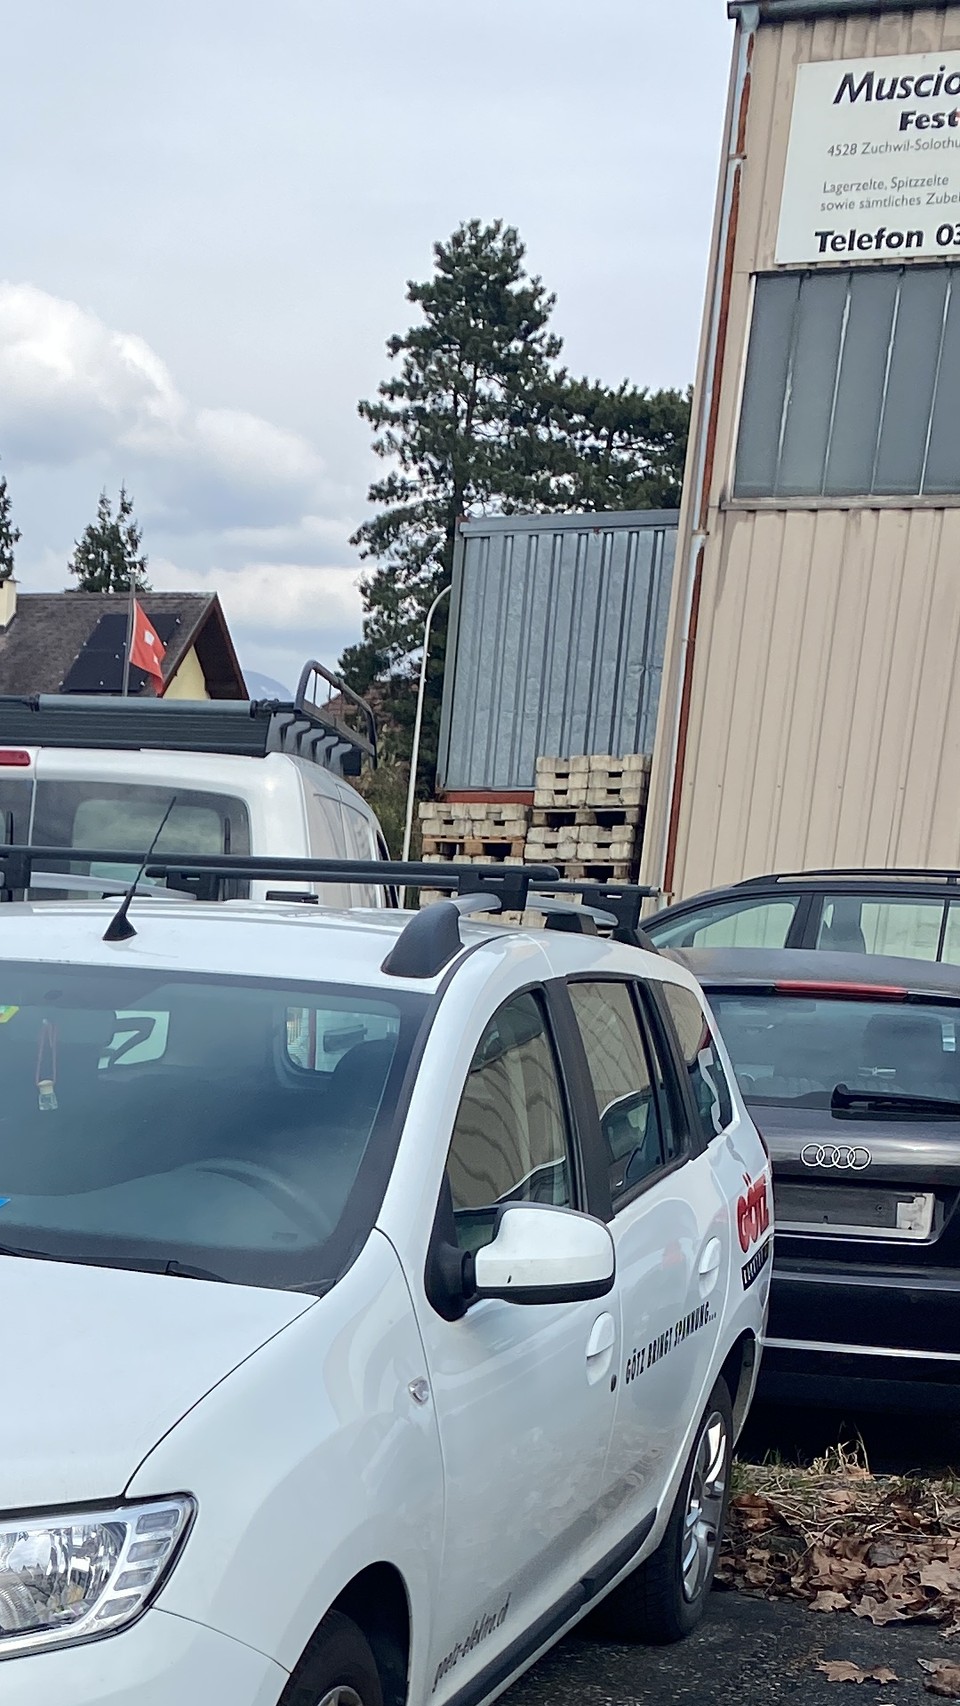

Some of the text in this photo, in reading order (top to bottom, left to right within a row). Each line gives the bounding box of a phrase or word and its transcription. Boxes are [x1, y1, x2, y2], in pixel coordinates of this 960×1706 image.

[833, 65, 960, 104] Muscio
[827, 143, 858, 157] 4528
[823, 174, 949, 196] Lagerzelte, Spitzzelte
[820, 200, 855, 211] sowie
[859, 194, 921, 209] sämtliches
[815, 226, 924, 253] Telefon
[626, 1347, 646, 1385] GÖTZ
